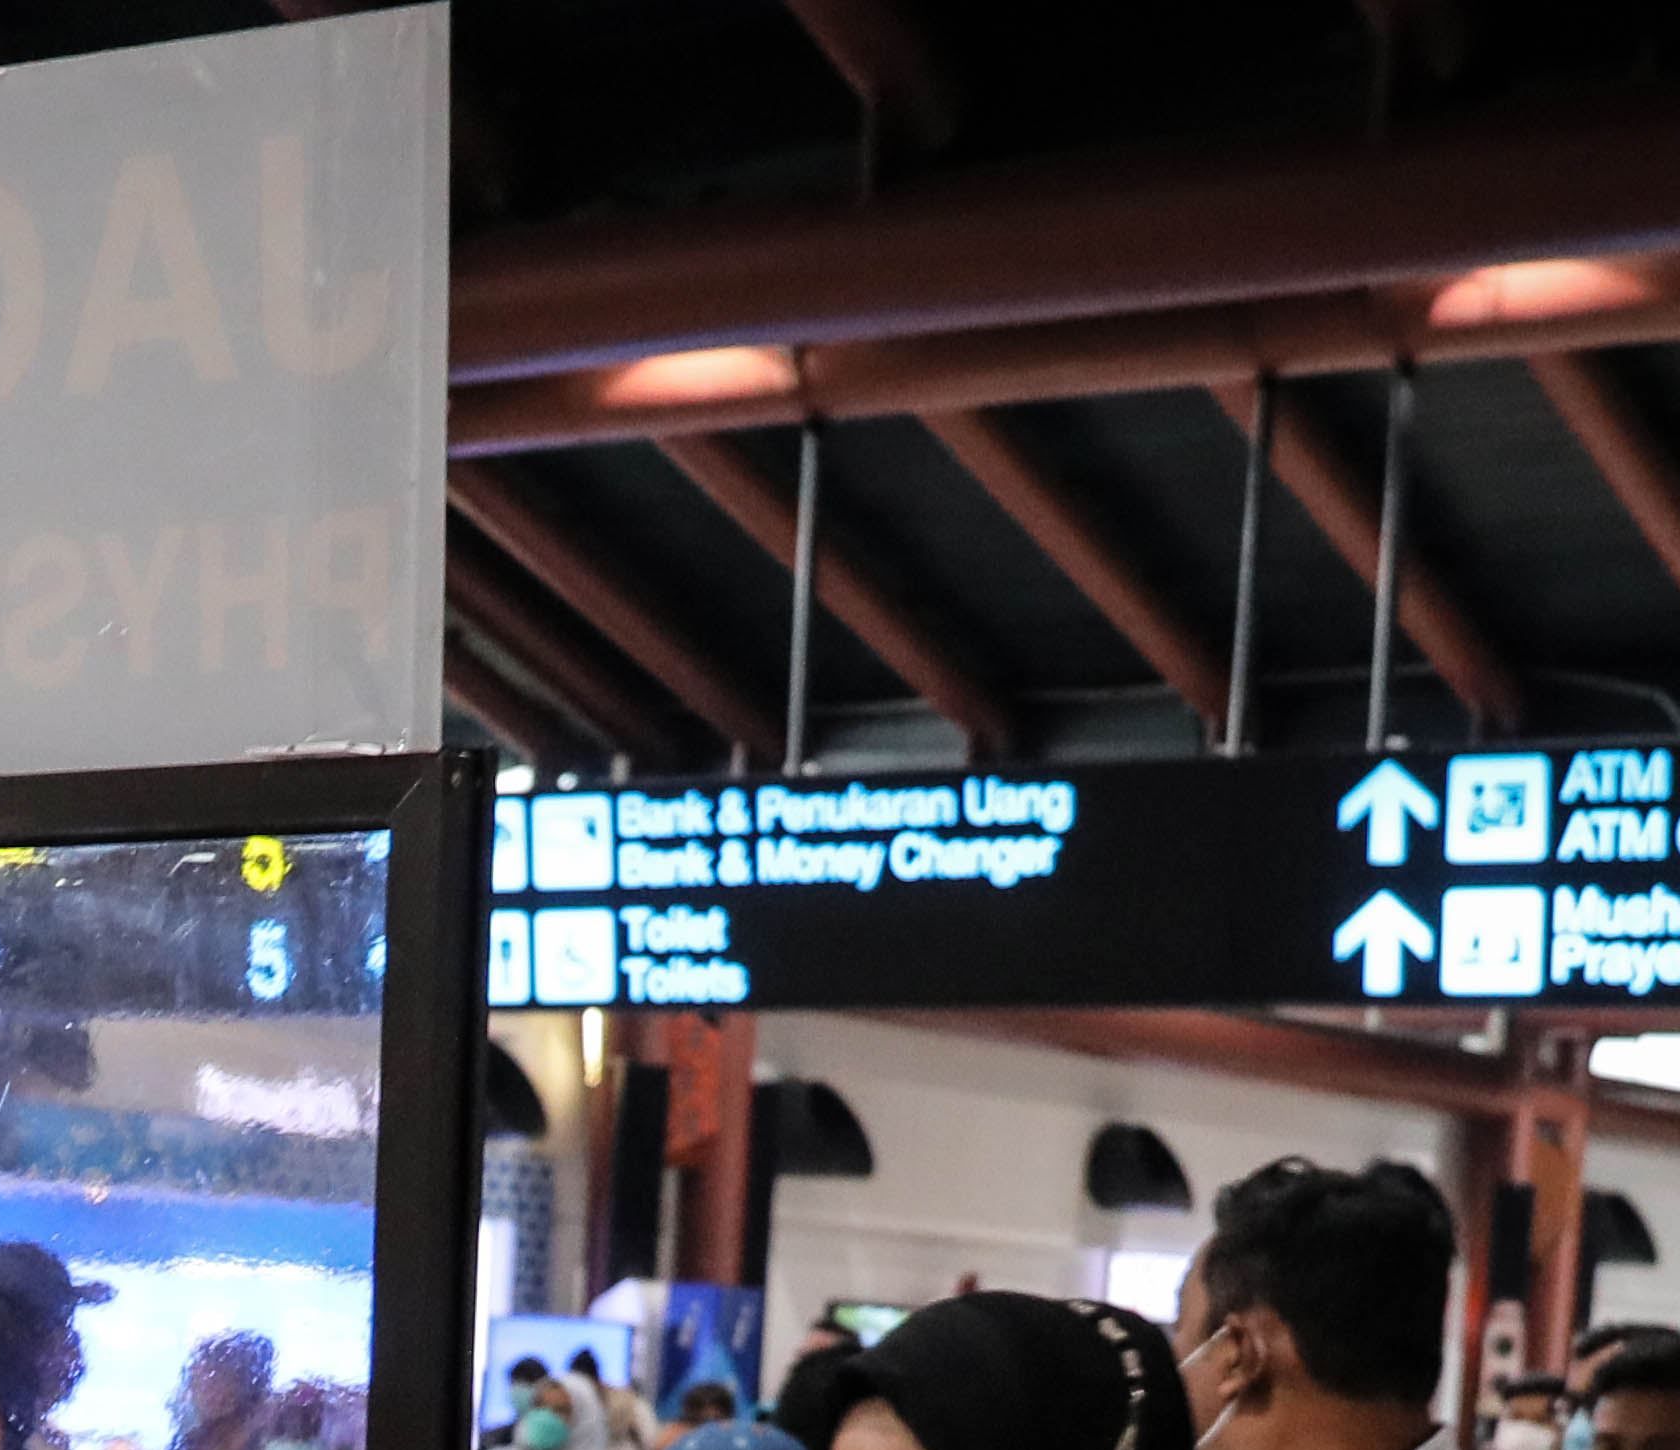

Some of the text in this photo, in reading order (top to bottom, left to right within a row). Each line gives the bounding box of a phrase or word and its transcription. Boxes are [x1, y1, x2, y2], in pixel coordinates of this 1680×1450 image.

[1559, 748, 1673, 803] ATM
[618, 776, 1076, 838] Bank & Penukaran Uang
[1555, 807, 1670, 862] ATM
[617, 832, 1063, 891] Bank & Money Changer
[619, 905, 730, 953] Toilet
[621, 957, 750, 1003] Toilets
